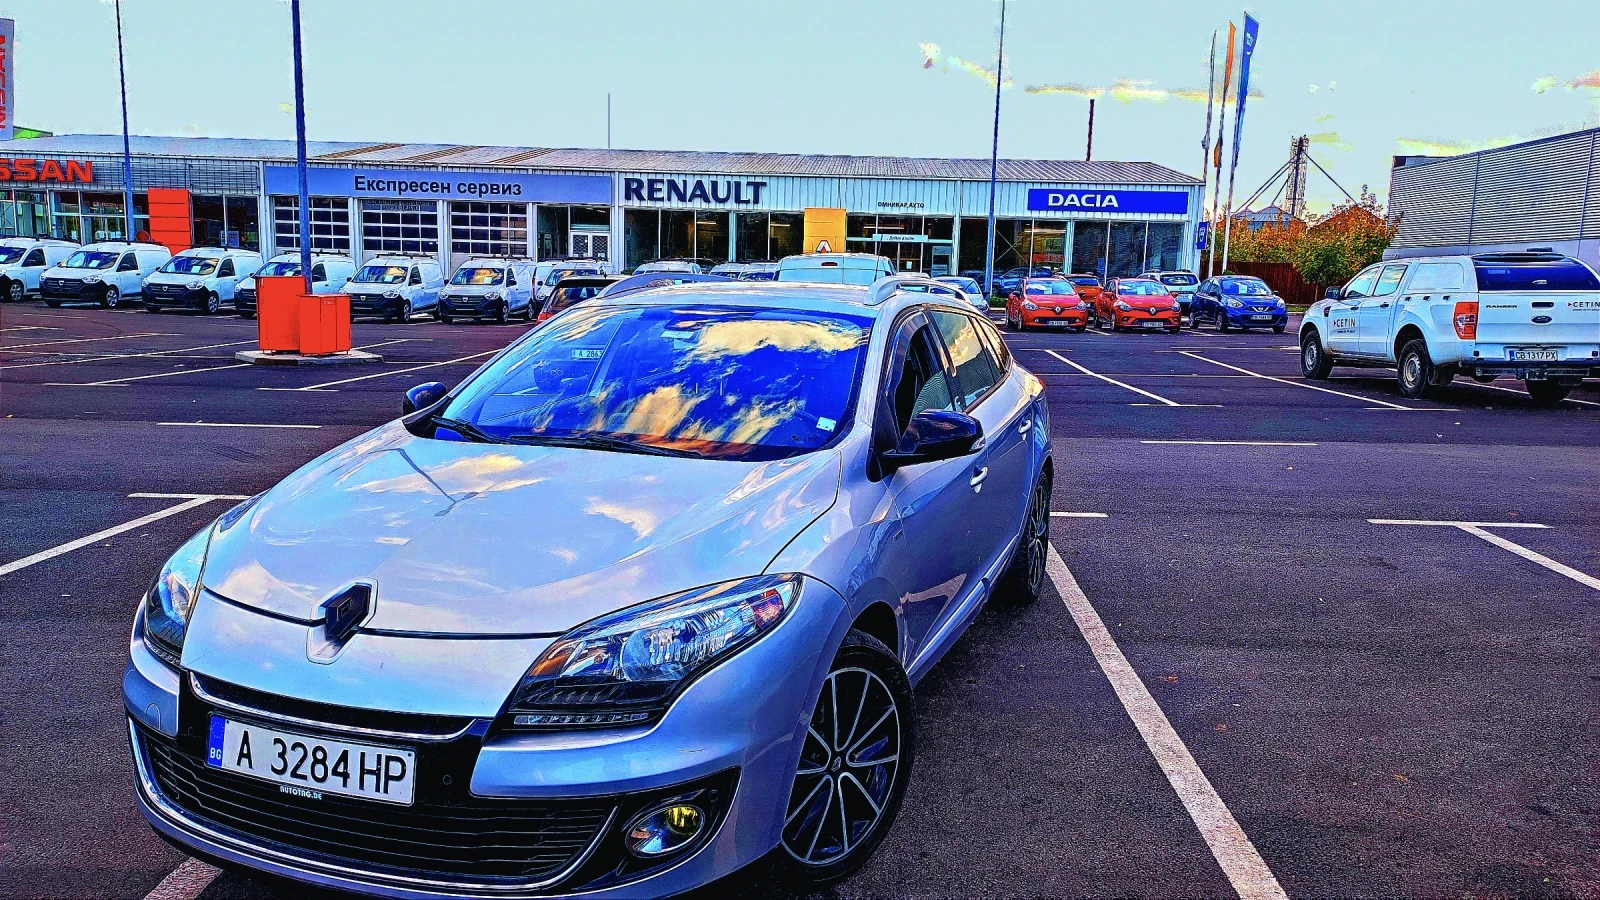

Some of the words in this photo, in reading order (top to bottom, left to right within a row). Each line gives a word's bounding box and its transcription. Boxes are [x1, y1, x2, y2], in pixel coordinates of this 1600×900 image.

[354, 175, 450, 195] Експресен
[457, 181, 522, 198] сервиз
[624, 177, 767, 205] RENAULT
[1048, 193, 1119, 208] DACIA
[1336, 318, 1356, 328] CETIN
[209, 747, 222, 760] BG
[236, 730, 254, 770] A
[270, 737, 350, 788] 3284
[359, 751, 407, 795] HP
